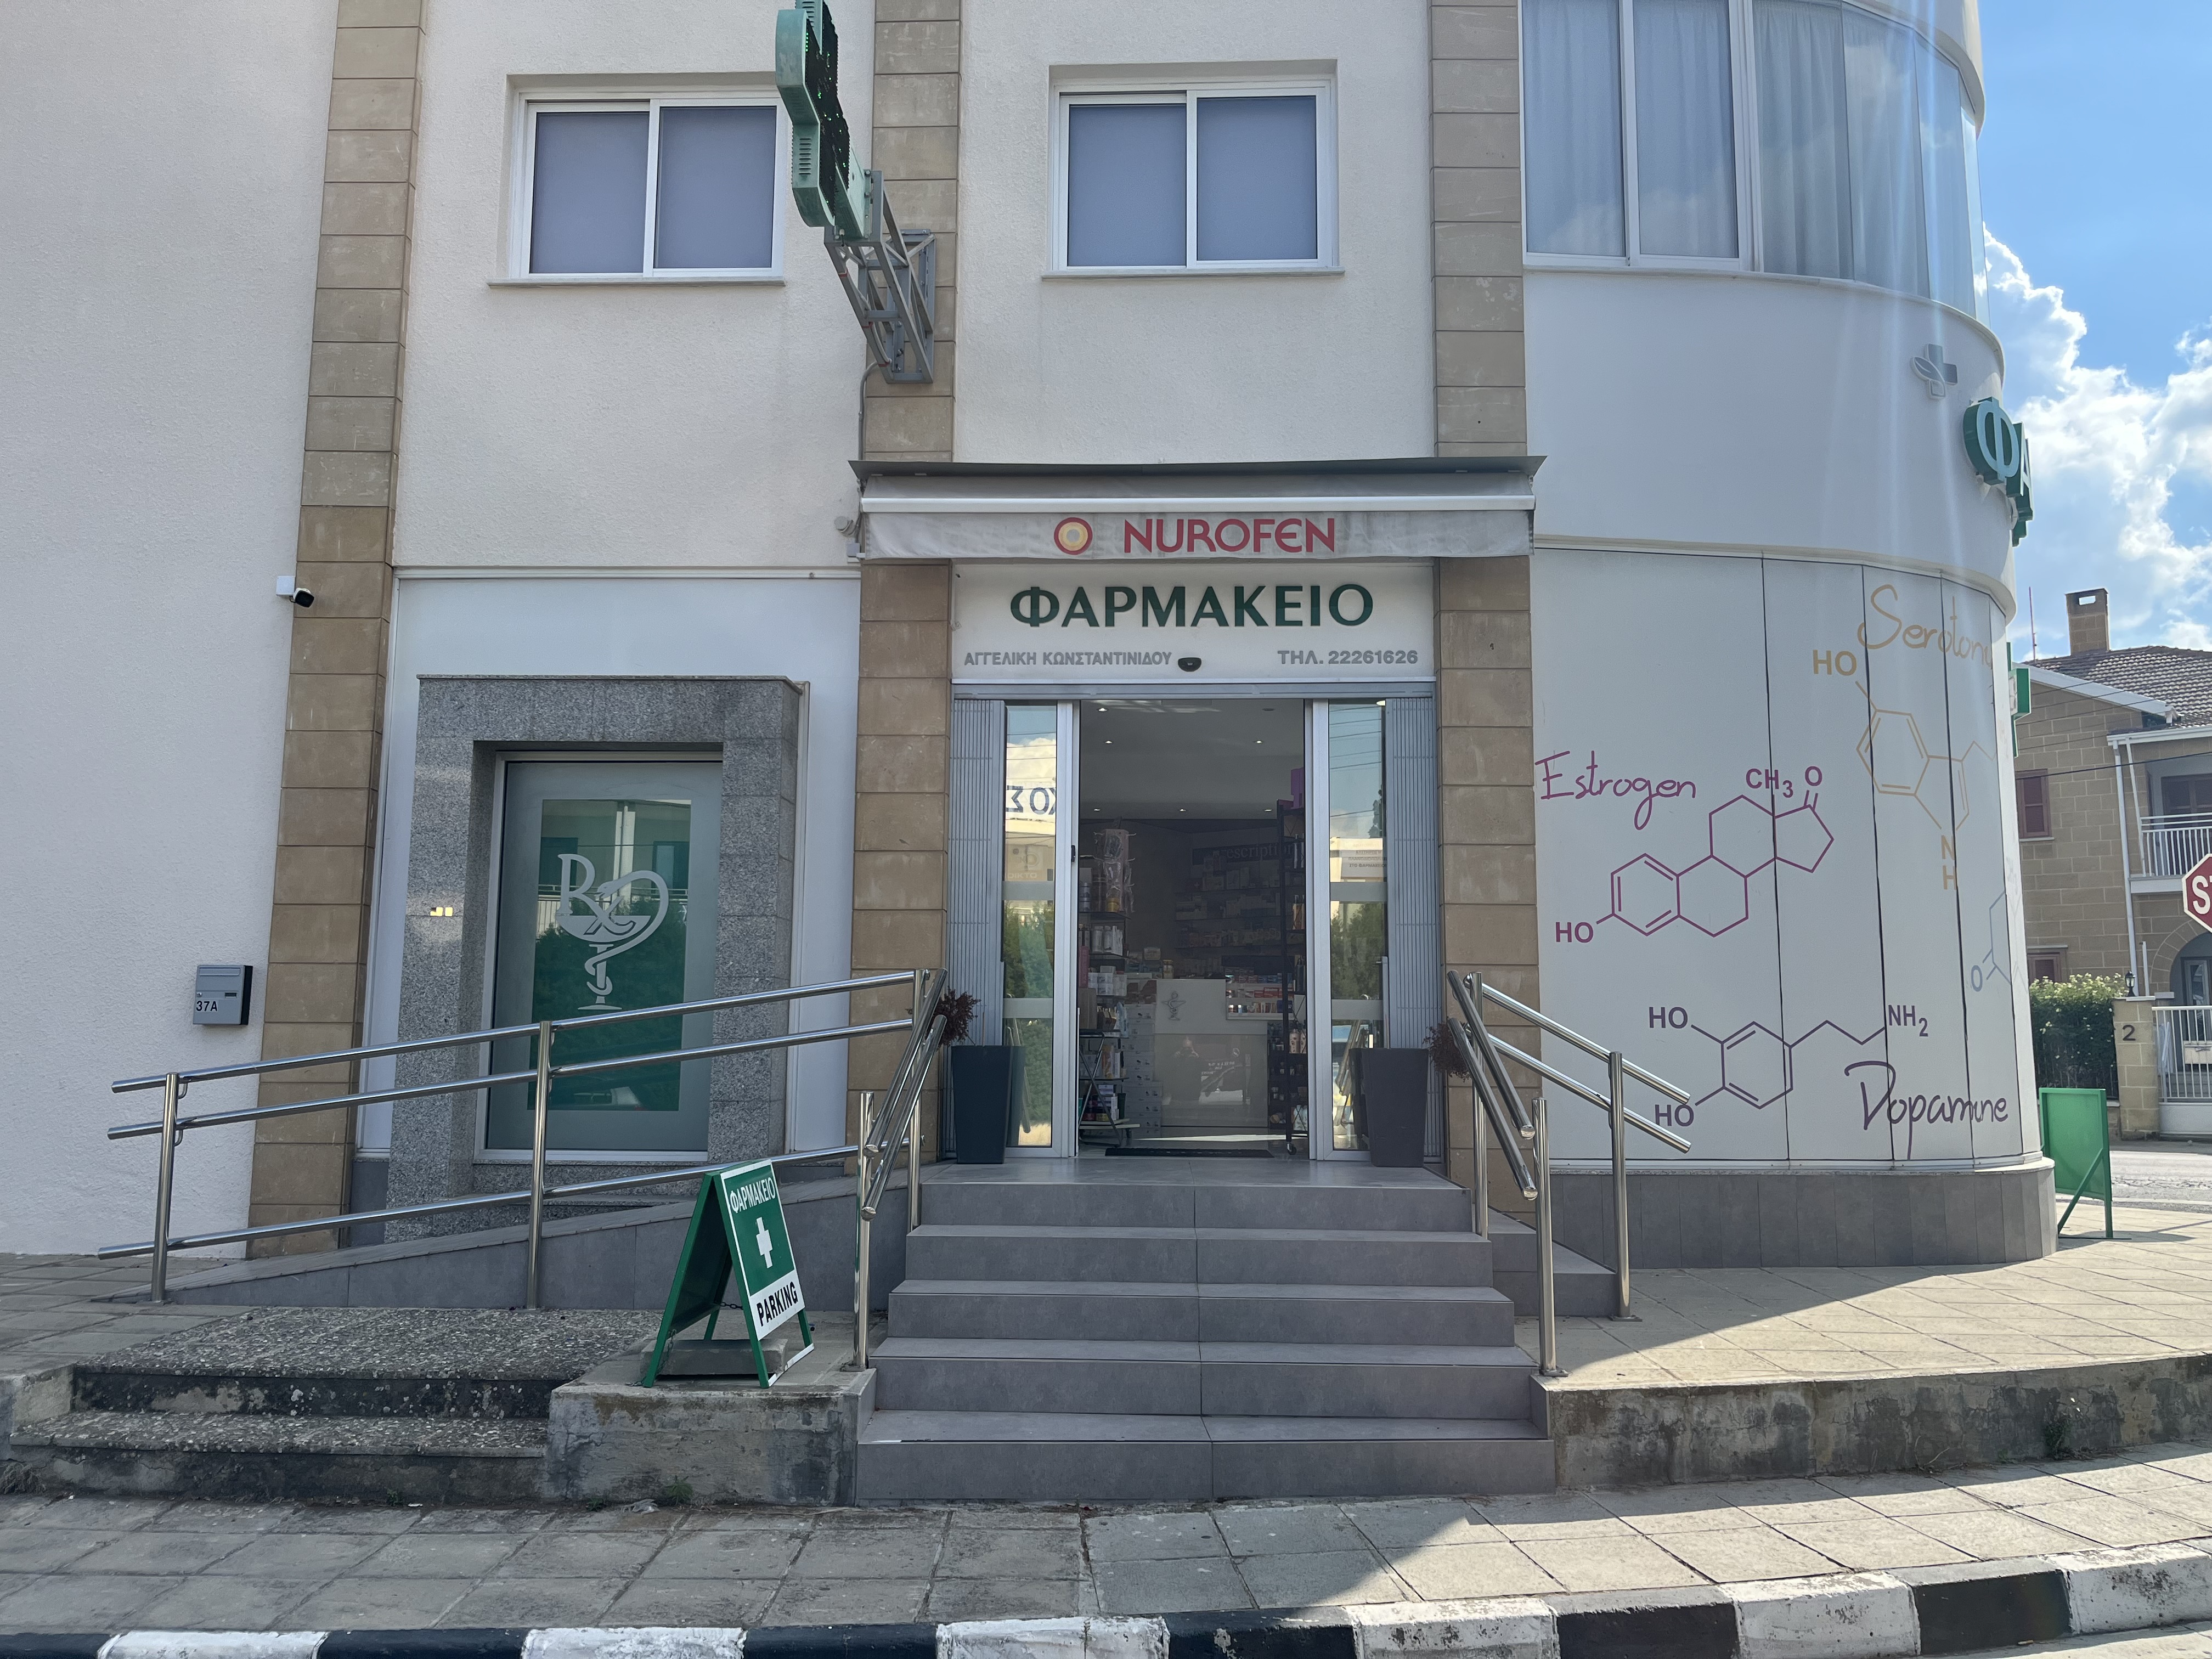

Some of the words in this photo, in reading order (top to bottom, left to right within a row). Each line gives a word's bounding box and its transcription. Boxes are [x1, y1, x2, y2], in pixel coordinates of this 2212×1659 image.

[1124, 517, 1335, 554] NUROFEN
[1010, 584, 1373, 628] ΦΑΡΜΑΚΕΙΟ
[964, 652, 1036, 665] ΑΓΓΕΛΙΚΗ
[1043, 651, 1172, 665] ΚΩΝΣΤΑΝΤΙΝΙΔΟΥ
[1278, 650, 1324, 664] ΤΗΛ.
[1328, 650, 1418, 664] 22261626
[1813, 649, 1857, 676] HO
[1805, 766, 1822, 786] O
[1535, 750, 1696, 831] Estrogen
[2192, 875, 2212, 915] S
[1556, 922, 1594, 943] HO
[196, 1001, 218, 1012] 37A
[1649, 1007, 1688, 1029] HO
[1888, 1005, 1929, 1037] NH2
[2122, 1024, 2136, 1041] 2
[1655, 1104, 1695, 1126] HO
[1844, 1061, 2008, 1160] Dopamine
[730, 1177, 776, 1214] ΦΑΡΜΑΚΕΙΟ
[757, 1281, 799, 1327] PARKING
